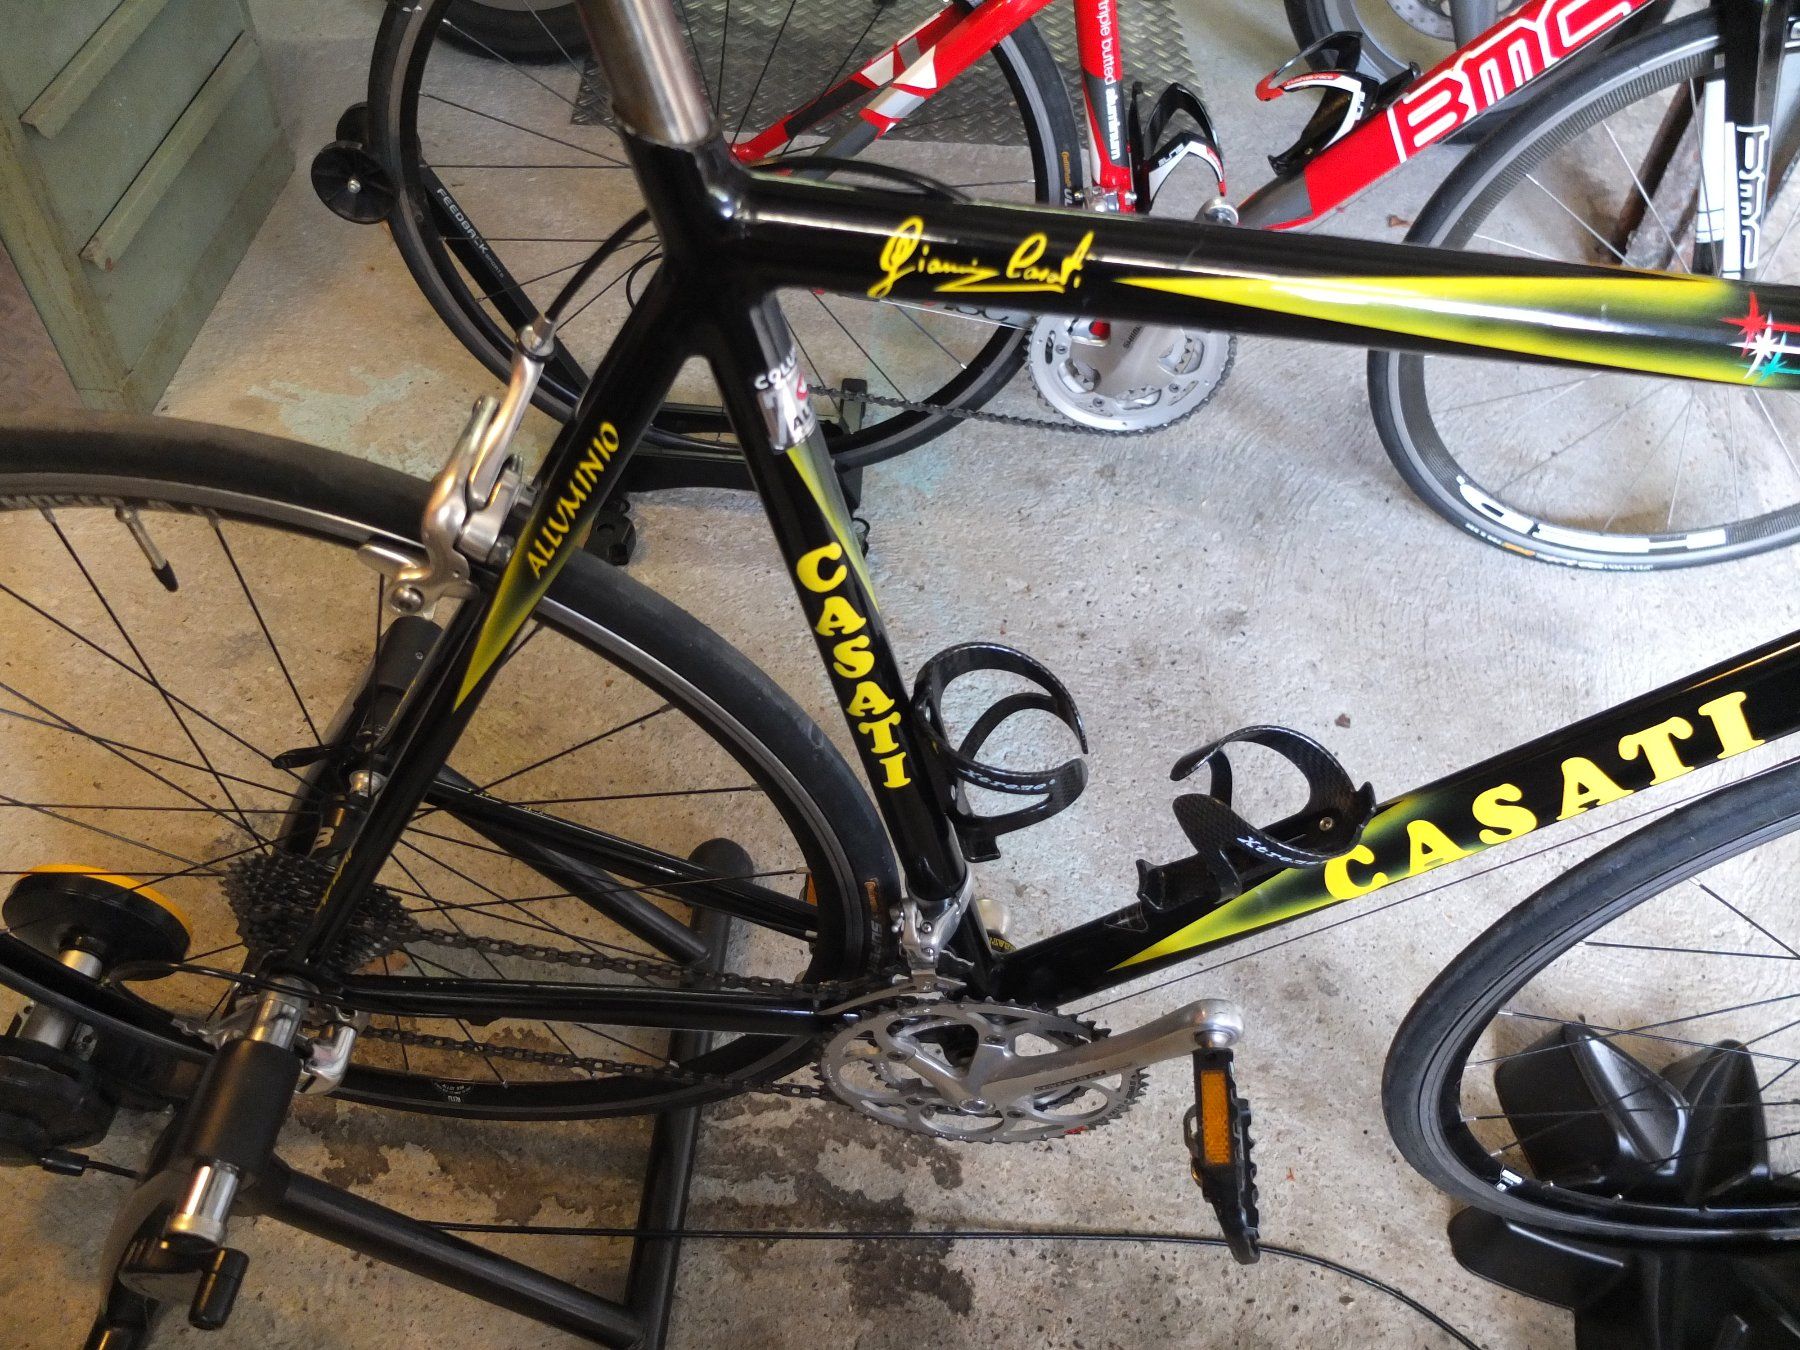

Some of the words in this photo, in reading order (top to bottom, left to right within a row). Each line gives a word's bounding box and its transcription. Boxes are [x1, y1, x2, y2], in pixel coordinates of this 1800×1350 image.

[1101, 38, 1117, 85] butted
[1105, 88, 1121, 161] aluminum
[1386, 0, 1633, 164] BMC
[796, 541, 911, 789] CASATI
[1324, 690, 1767, 900] CASATI
